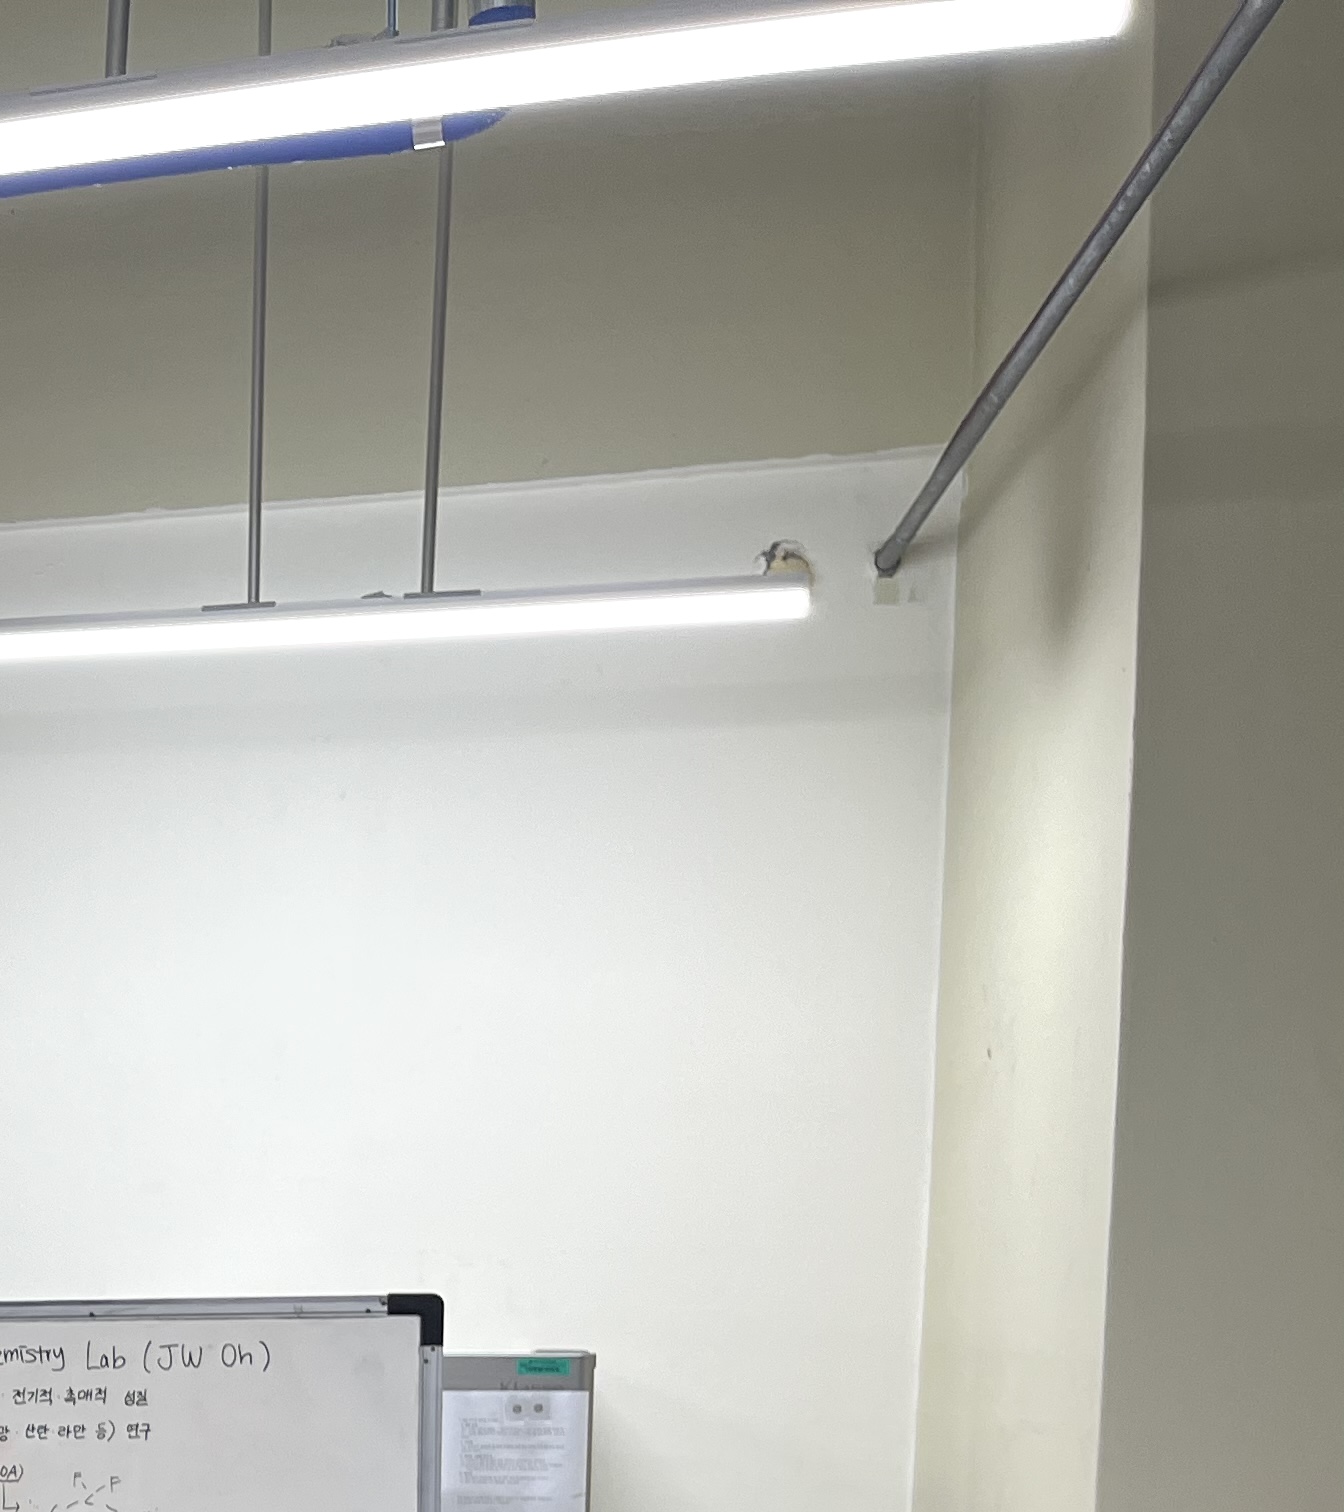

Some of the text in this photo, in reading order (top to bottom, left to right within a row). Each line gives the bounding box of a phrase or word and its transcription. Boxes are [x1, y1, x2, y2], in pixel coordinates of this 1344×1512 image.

[86, 1340, 126, 1371] Lab
[143, 1340, 203, 1373] (JW
[221, 1340, 271, 1373] Oh)
[12, 1386, 53, 1407] 전기적
[126, 1422, 152, 1442] 연구
